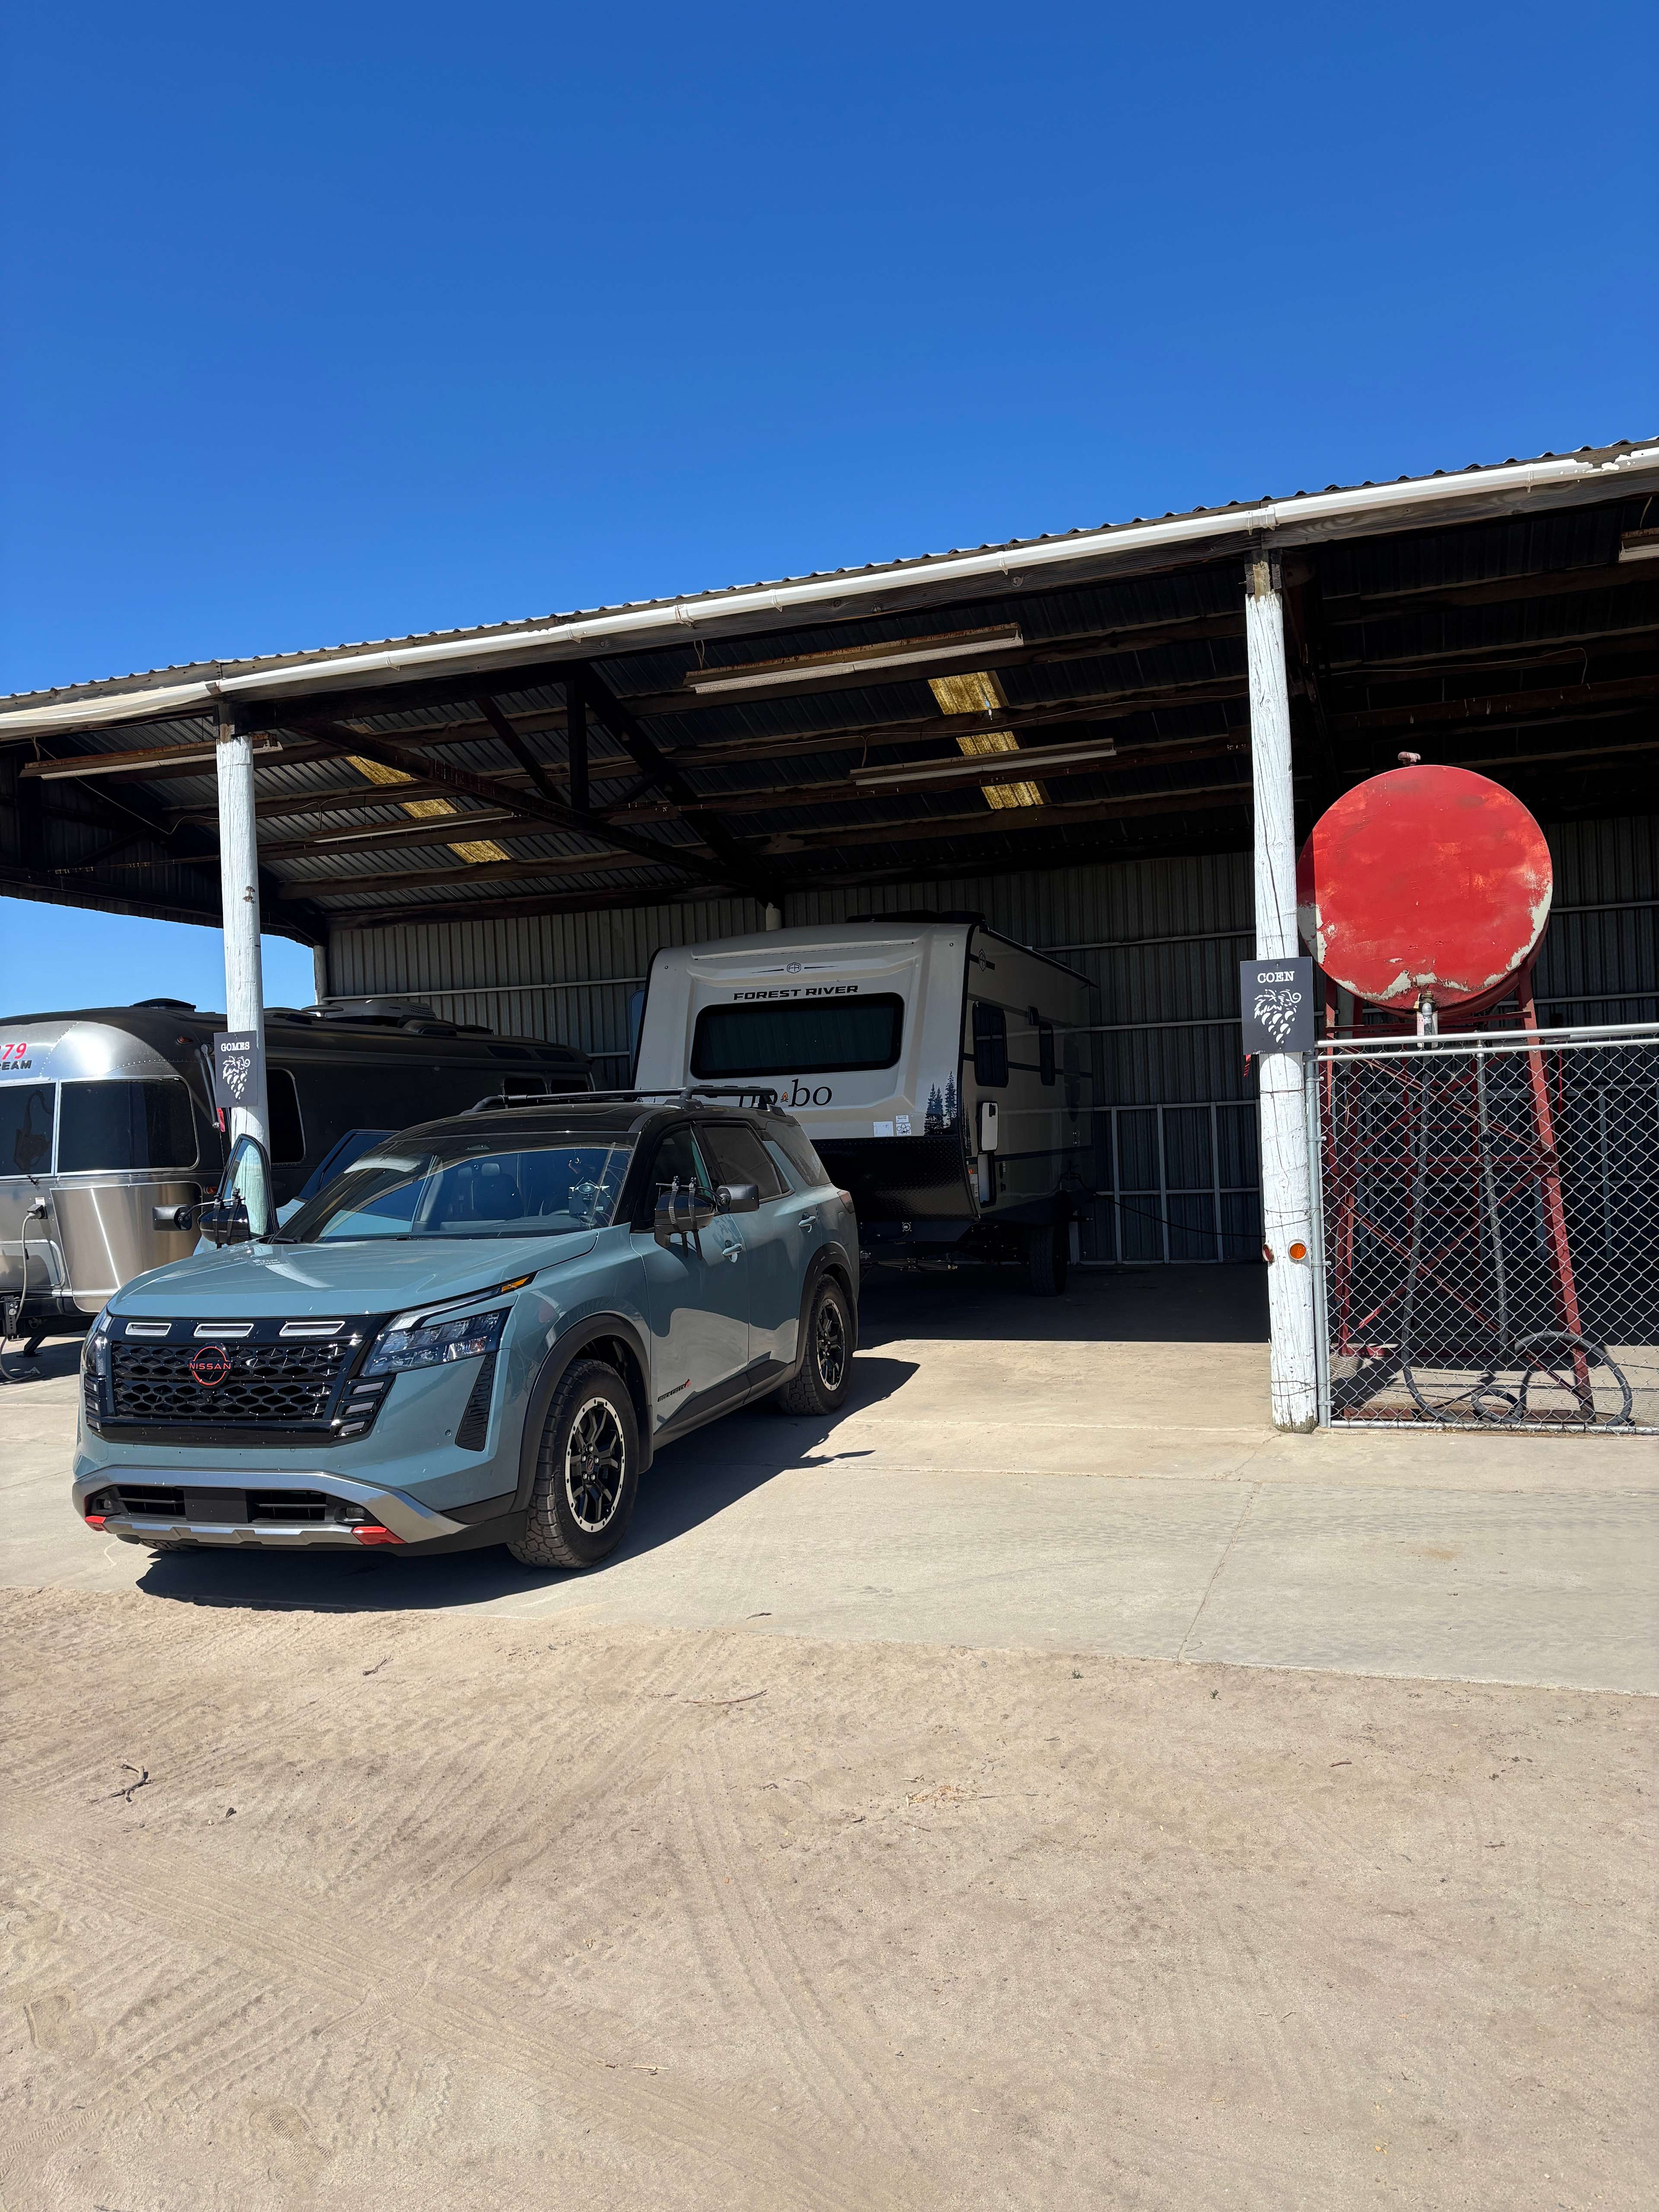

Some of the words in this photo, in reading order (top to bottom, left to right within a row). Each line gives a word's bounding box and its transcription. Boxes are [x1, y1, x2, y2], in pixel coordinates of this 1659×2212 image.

[1257, 971, 1295, 983] COEN
[734, 989, 801, 1000] FOREST
[805, 985, 858, 996] RIVER
[0, 1042, 27, 1060] 79
[221, 1042, 250, 1052] GOMES
[0, 1060, 32, 1071] EAM
